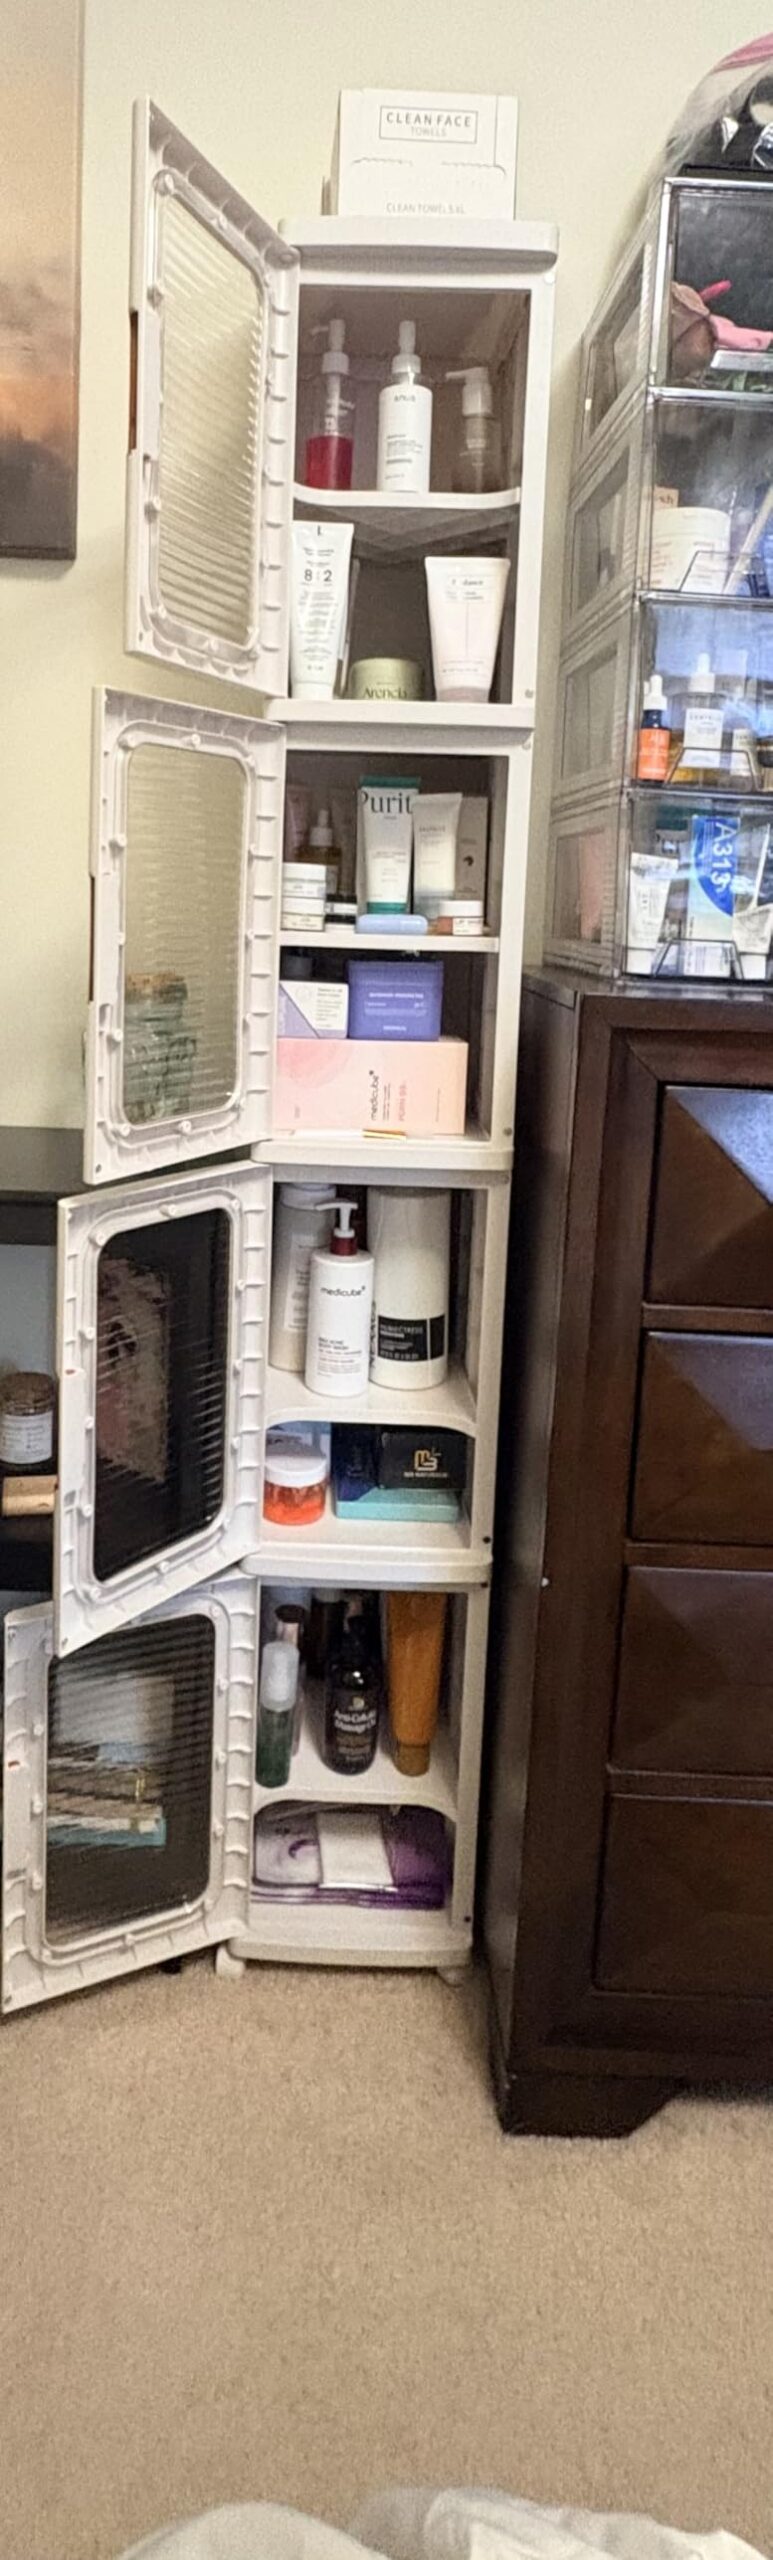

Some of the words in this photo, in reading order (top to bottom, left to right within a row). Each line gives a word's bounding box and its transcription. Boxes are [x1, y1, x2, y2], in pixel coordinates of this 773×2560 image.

[386, 111, 432, 126] CLEAN
[436, 114, 472, 128] FACE
[411, 126, 448, 137] TOWELS
[386, 202, 416, 213] CLEAN
[711, 822, 738, 886] A313
[321, 1286, 362, 1297] medicube
